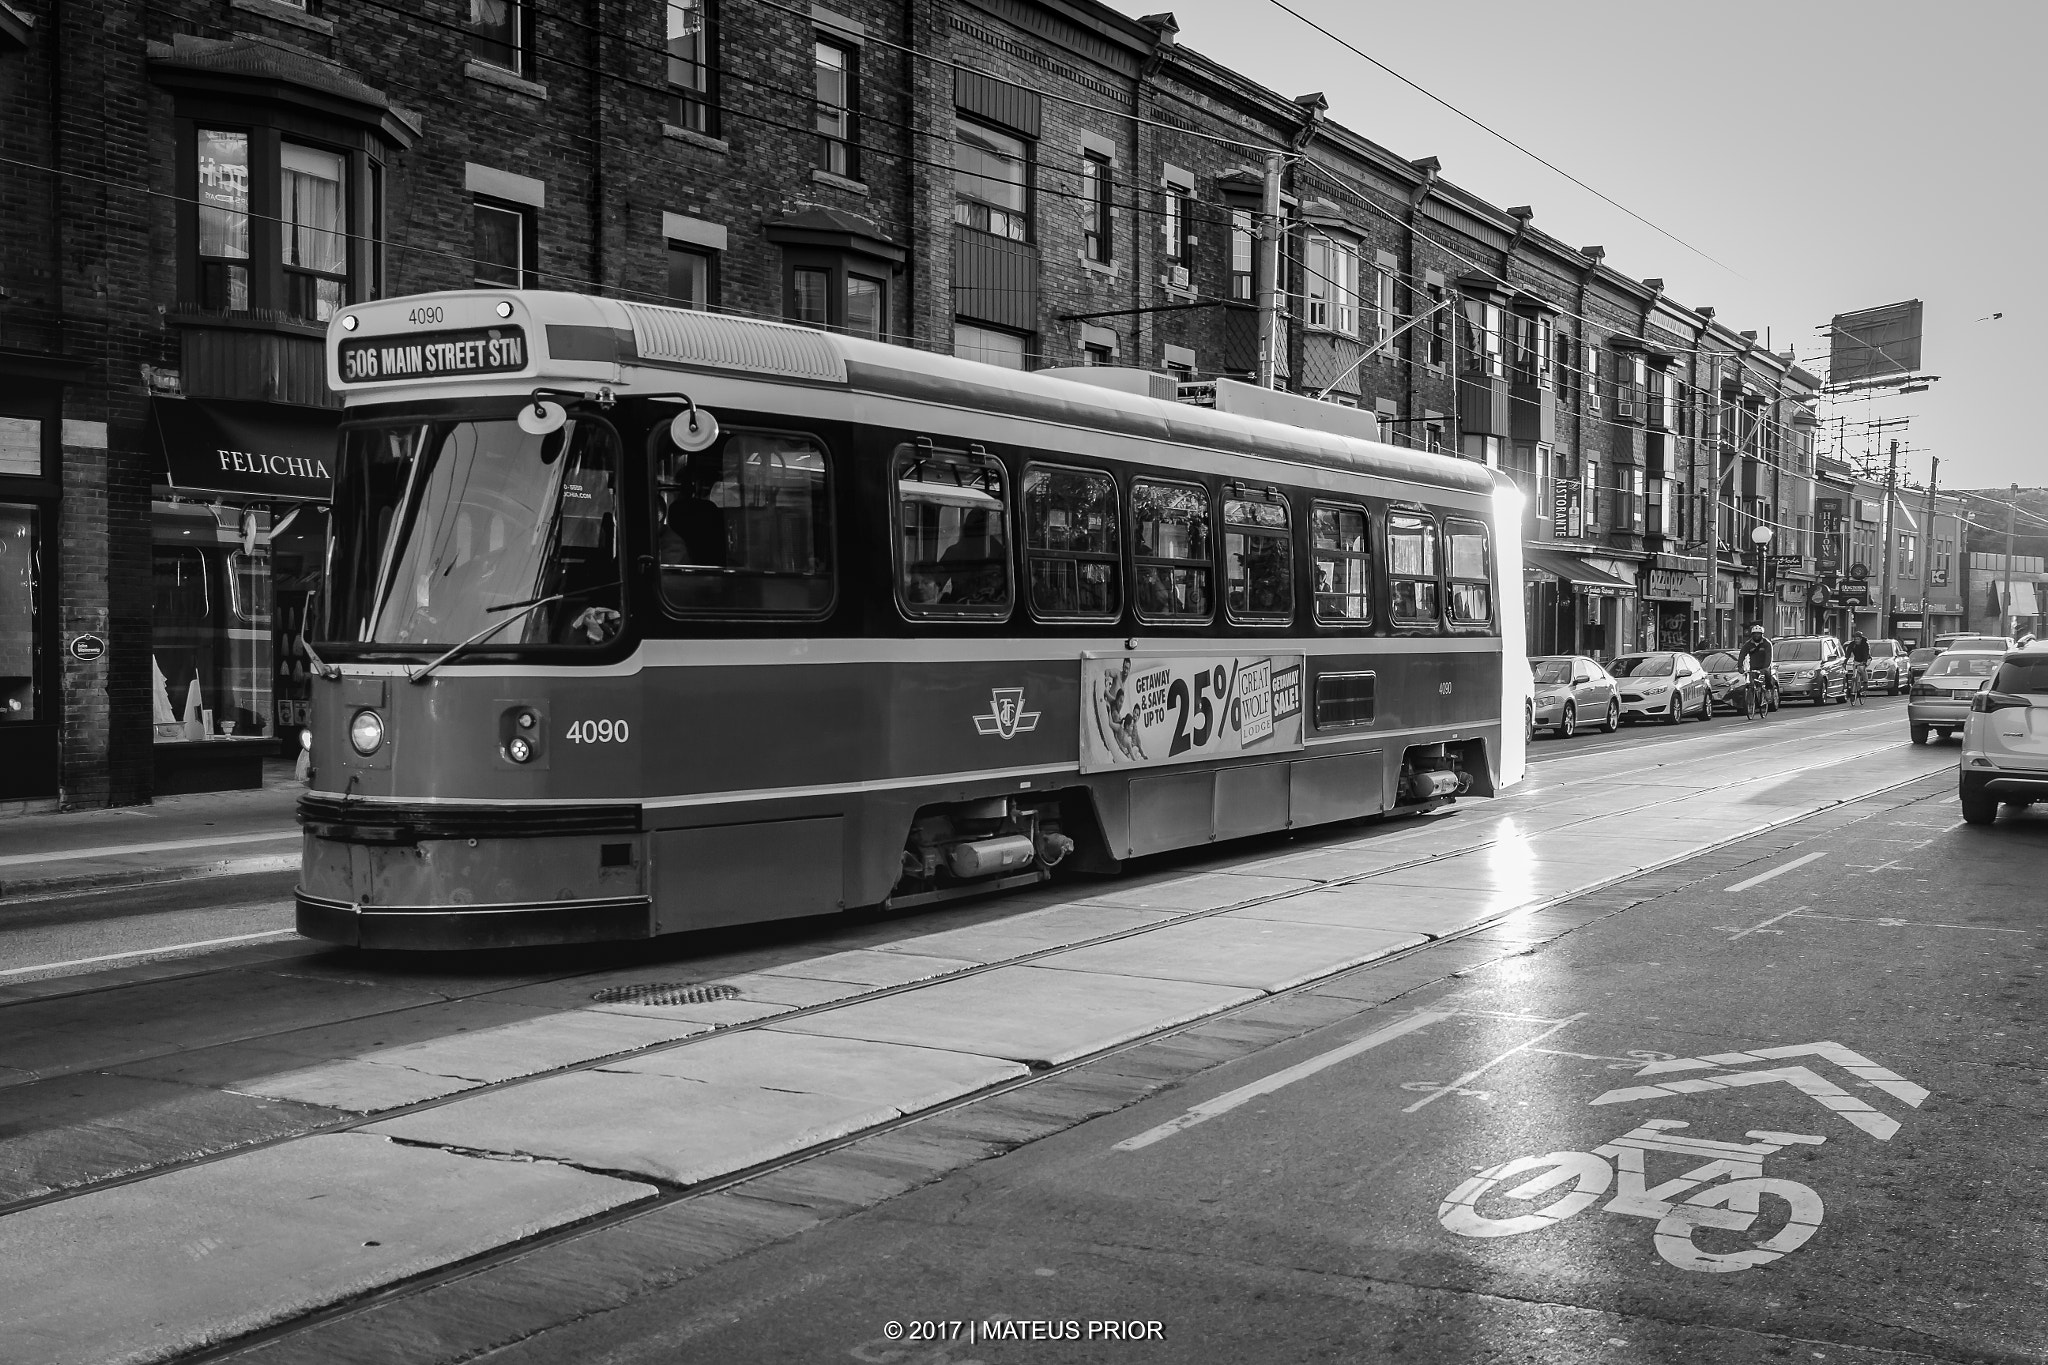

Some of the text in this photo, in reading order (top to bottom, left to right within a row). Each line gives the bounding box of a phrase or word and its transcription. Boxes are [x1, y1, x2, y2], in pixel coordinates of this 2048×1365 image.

[409, 306, 444, 325] 4090
[345, 337, 522, 379] 506 MAIN STREET STN
[217, 449, 332, 479] FELICHIA
[1555, 478, 1567, 537] RISTORANTE
[1821, 512, 1832, 557] HOGTOWN
[1135, 668, 1171, 694] GETAWAY
[1241, 666, 1269, 695] GREAT
[1272, 669, 1299, 692] GETAWAY
[1141, 691, 1166, 709] & SAVE
[1167, 657, 1241, 758] 25%
[1241, 691, 1270, 720] WOLF
[1273, 685, 1299, 717] SALE!
[566, 719, 629, 744] 4090
[1143, 707, 1165, 728] UP TO
[1243, 720, 1271, 739] LODGE
